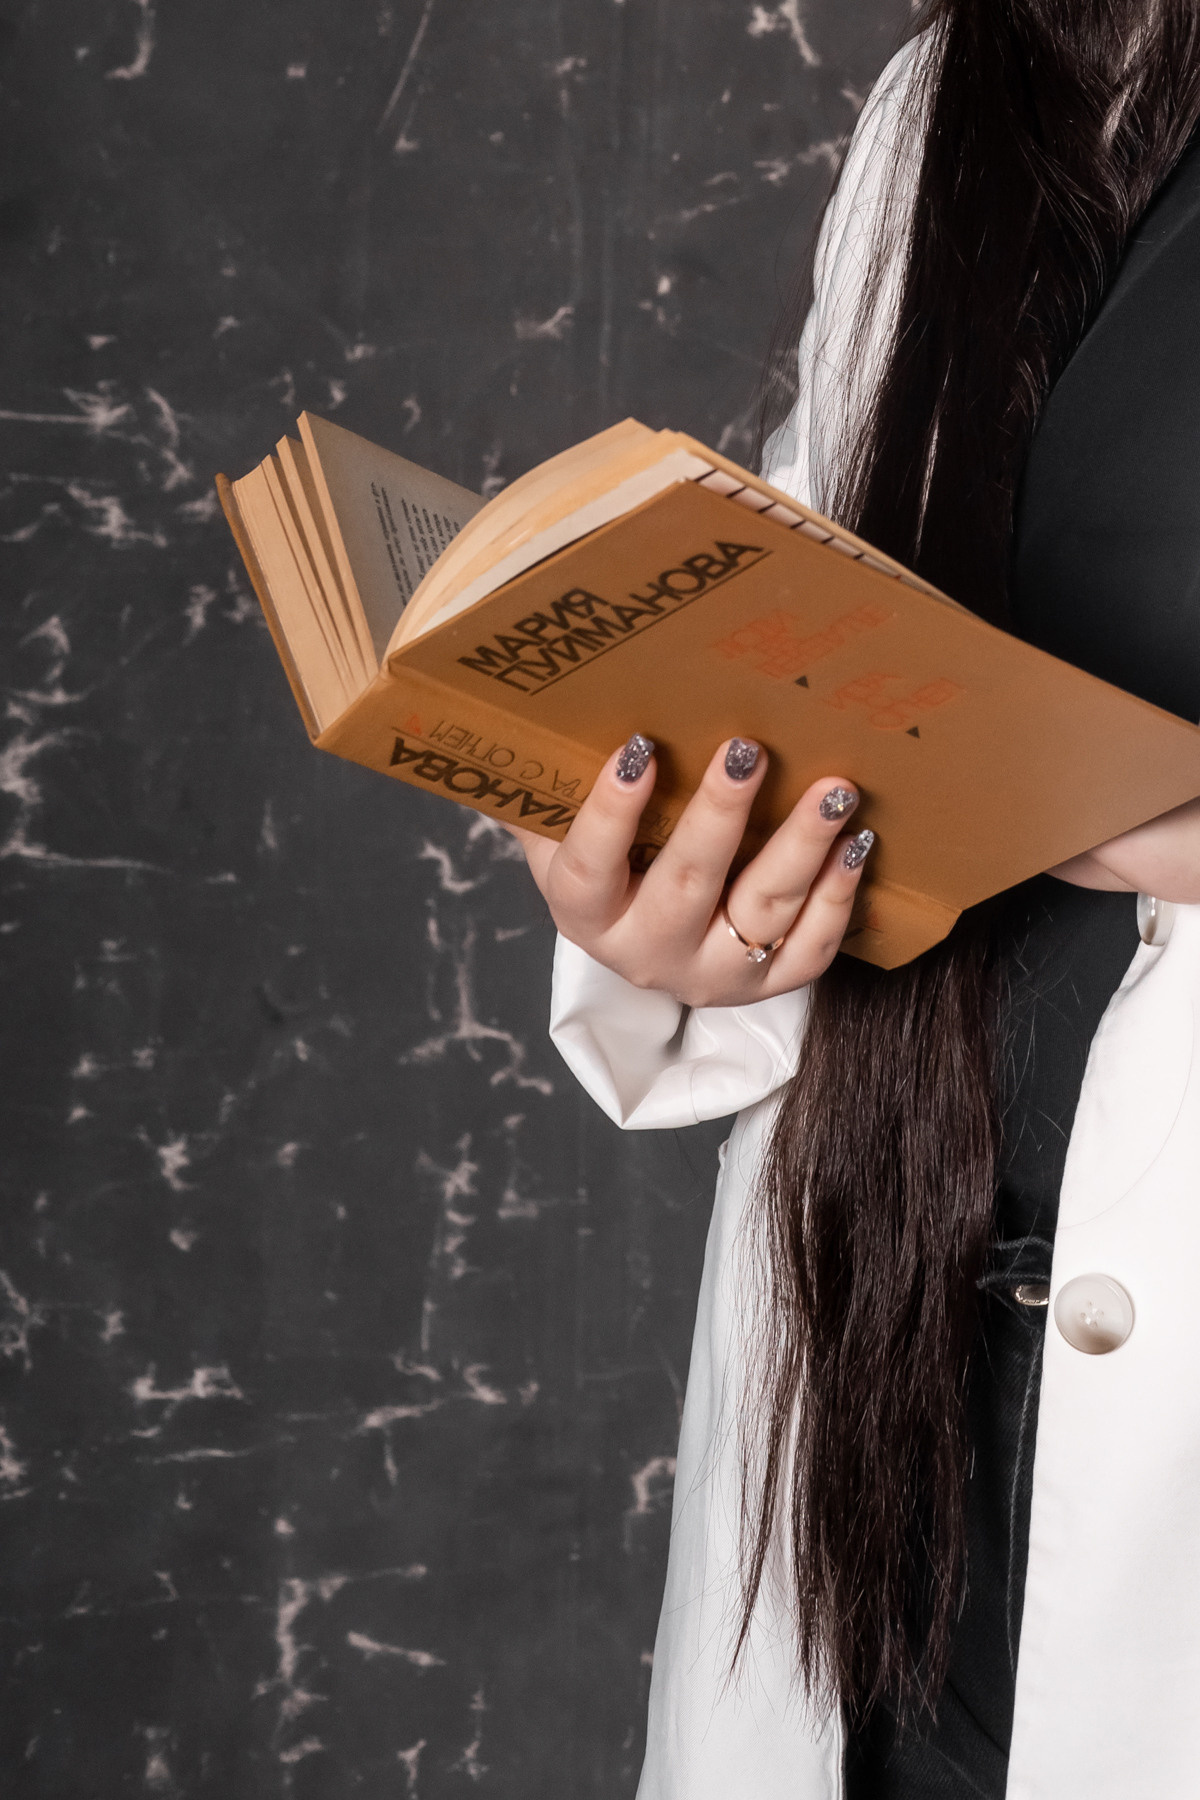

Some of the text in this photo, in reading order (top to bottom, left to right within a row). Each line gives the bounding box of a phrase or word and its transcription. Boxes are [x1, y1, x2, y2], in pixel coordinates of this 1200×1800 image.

[457, 587, 611, 677] МАРИЯ
[495, 540, 765, 693] ПУЙМАНОВА
[388, 736, 577, 830] МАНОВА
[428, 719, 516, 769] ОГНЕМ
[552, 768, 590, 804] ГРА
